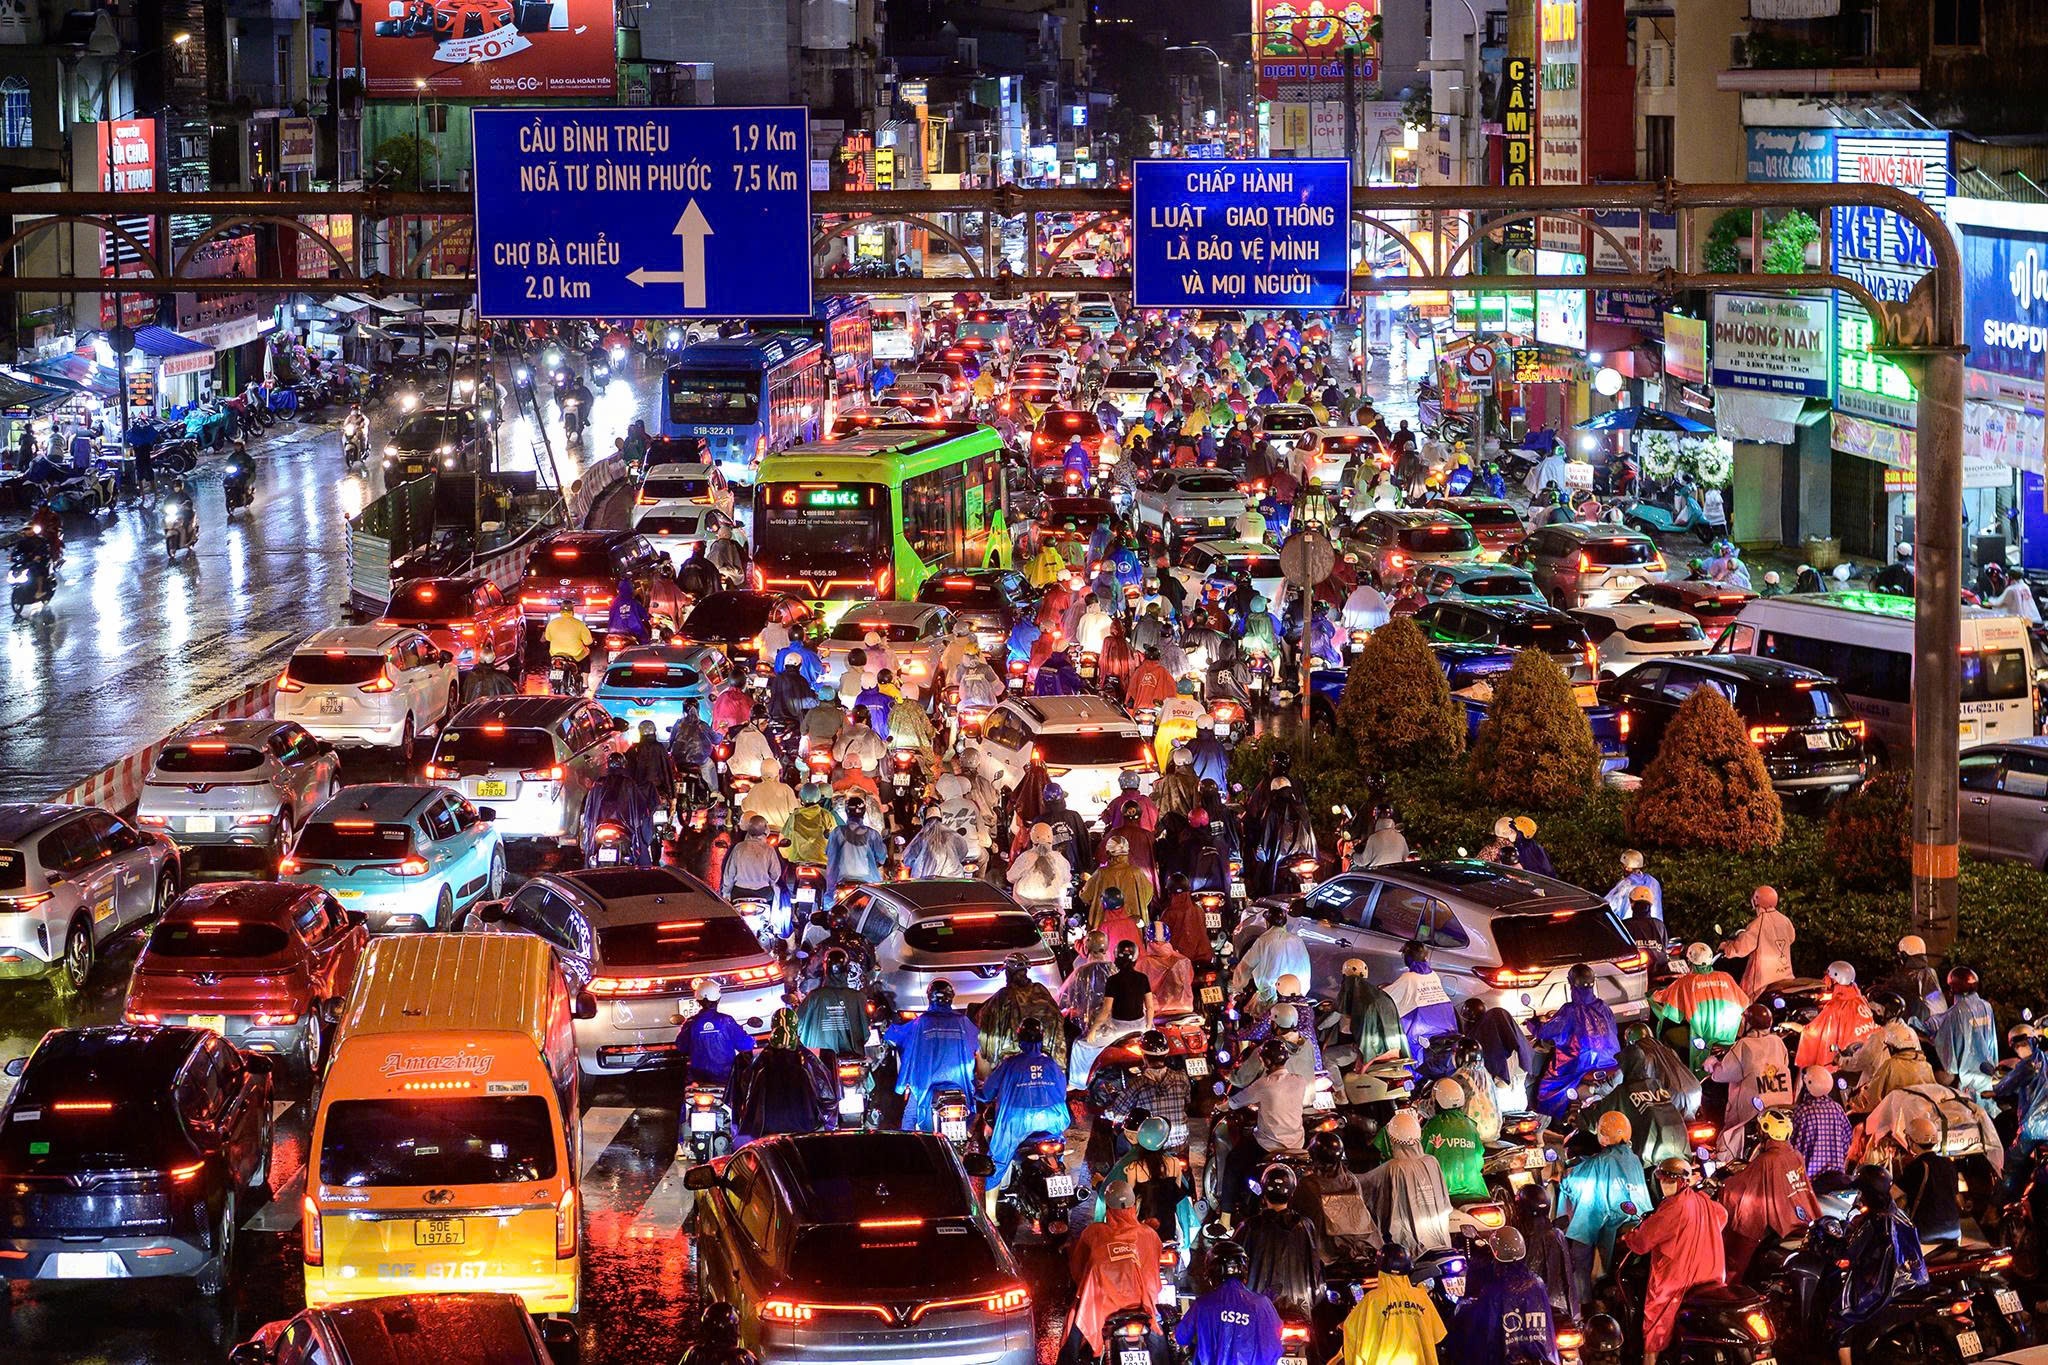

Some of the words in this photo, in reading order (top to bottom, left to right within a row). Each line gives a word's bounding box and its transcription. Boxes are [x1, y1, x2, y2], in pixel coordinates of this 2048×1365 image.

[468, 40, 502, 59] 50
[1264, 64, 1296, 80] DỊCH
[1300, 65, 1316, 80] VỤ
[1506, 61, 1526, 132] CẦM
[520, 118, 556, 152] CẦU
[564, 120, 608, 152] BÌNH
[614, 121, 670, 156] TRIỆU
[732, 124, 759, 153] 1,9
[767, 124, 796, 150] Km
[520, 162, 559, 192] NGÃ
[564, 164, 590, 192] TƯ
[596, 159, 641, 192] BÌNH
[648, 158, 712, 192] PHƯỚC
[733, 164, 760, 193] 7,5
[768, 164, 797, 190] Km
[1766, 156, 1832, 179] 0918.996.119
[1858, 156, 1896, 184] TRUNG
[1900, 150, 1925, 186] TÂM
[1186, 166, 1236, 192] CHẤP
[1242, 168, 1293, 192] HÀNH
[1152, 203, 1206, 231] LUẬT
[1226, 206, 1268, 226] GIAO
[1274, 204, 1334, 226] THÔNG
[494, 242, 530, 268] CHỢ
[537, 238, 560, 266] BÀ
[566, 232, 620, 264] CHIỂU
[1167, 234, 1190, 260] LÀ
[1198, 234, 1232, 260] BẢO
[1240, 238, 1264, 264] VỆ
[1270, 234, 1319, 260] MÌNH
[526, 276, 554, 300] 2,0
[560, 275, 590, 298] km
[1182, 270, 1204, 294] VÀ
[1212, 275, 1246, 298] MỌI
[1254, 268, 1310, 294] NGƯỜI
[1716, 320, 1780, 347] PHƯƠNG
[1784, 328, 1822, 352] NAM
[694, 426, 734, 436] 51B-322.41
[782, 490, 796, 504] 45
[380, 1050, 494, 1078] Amazing
[1756, 1073, 1788, 1094] NICE
[1629, 1089, 1662, 1108] BIDV
[1049, 1186, 1072, 1196] 350.89
[430, 1221, 450, 1232] 50E
[422, 1232, 459, 1244] 197.67
[378, 1264, 416, 1280] 50E
[1220, 1310, 1250, 1326] GS25
[1404, 1300, 1426, 1315] BANK
[1525, 1312, 1546, 1328] PTI
